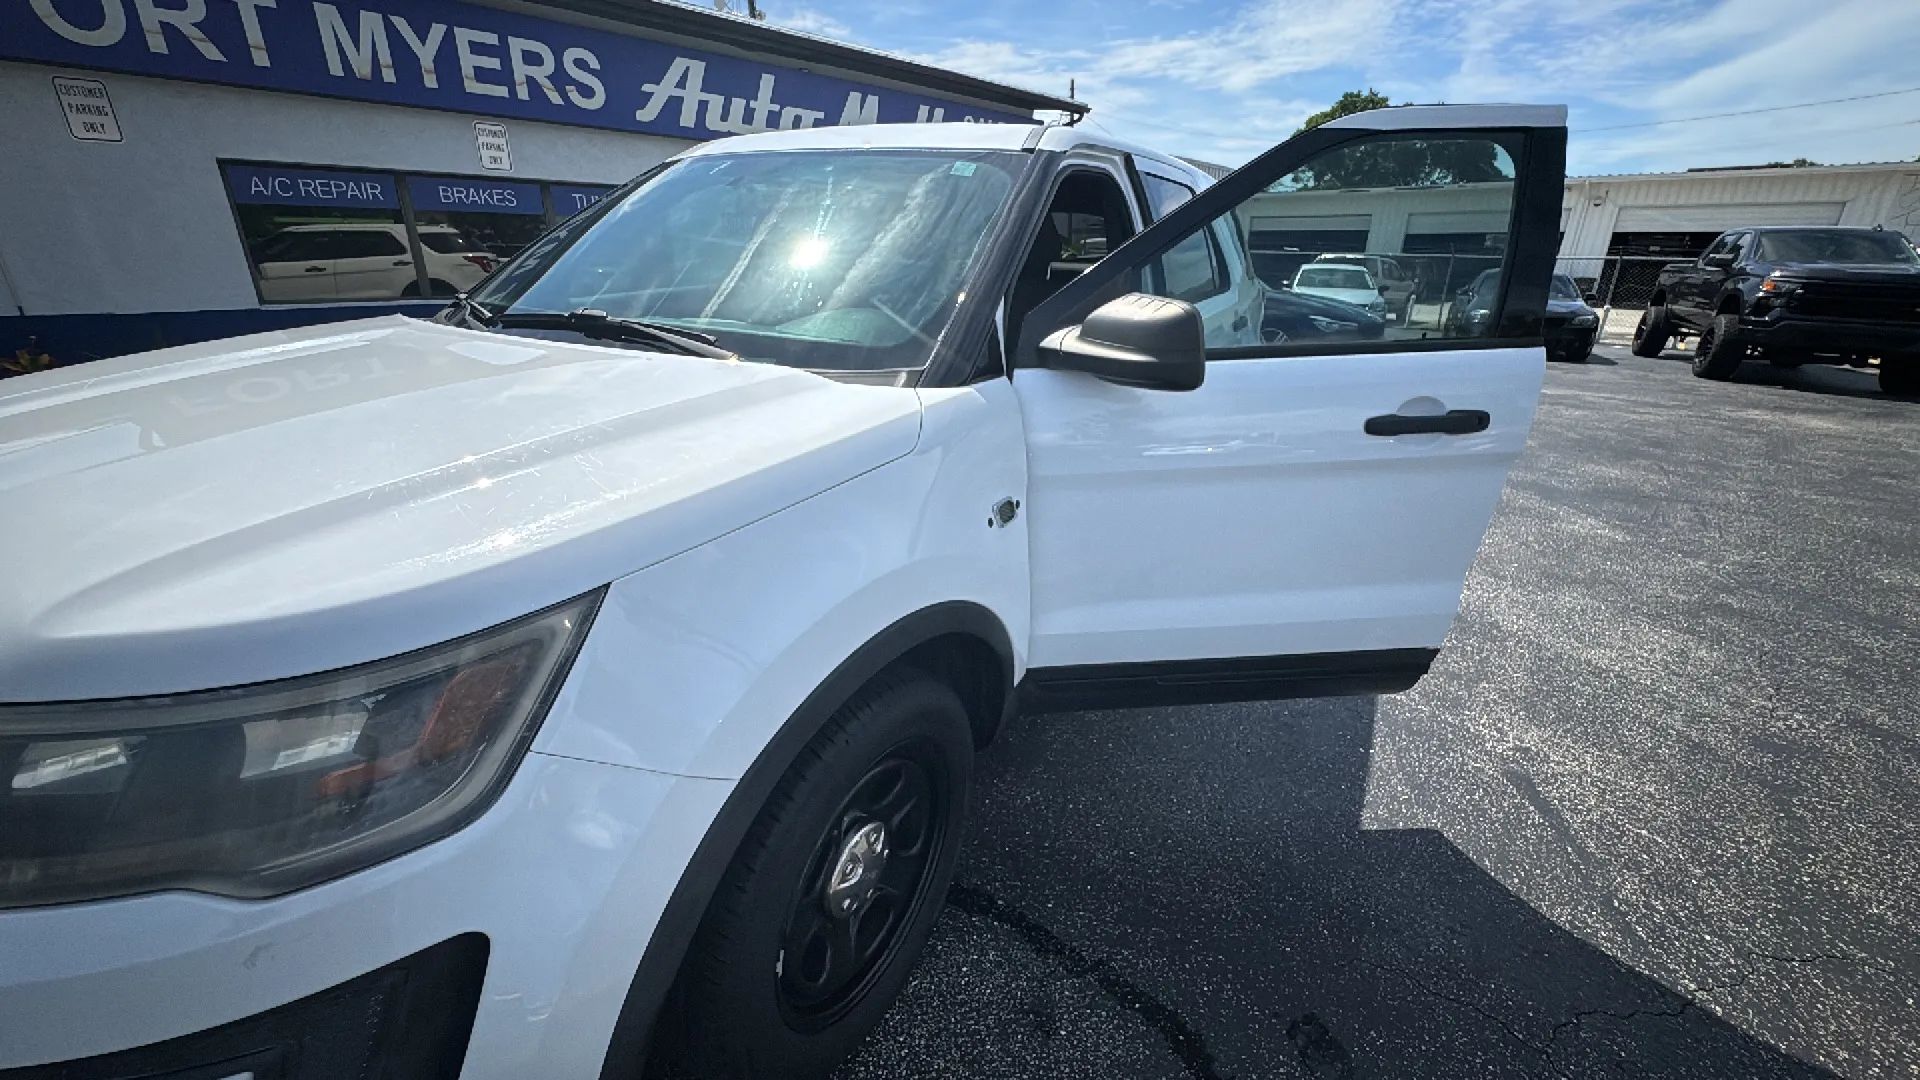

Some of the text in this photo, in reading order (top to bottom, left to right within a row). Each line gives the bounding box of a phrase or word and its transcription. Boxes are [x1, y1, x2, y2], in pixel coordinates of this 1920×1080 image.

[312, 1, 607, 110] MYERS
[635, 56, 826, 134] Auto
[58, 84, 105, 98] CUSTOMER
[67, 102, 109, 116] PARKING
[82, 121, 106, 134] ONLY
[477, 127, 504, 138] CUSTOMER
[251, 176, 384, 201] A/C REPAIR
[438, 185, 517, 207] BRAKES
